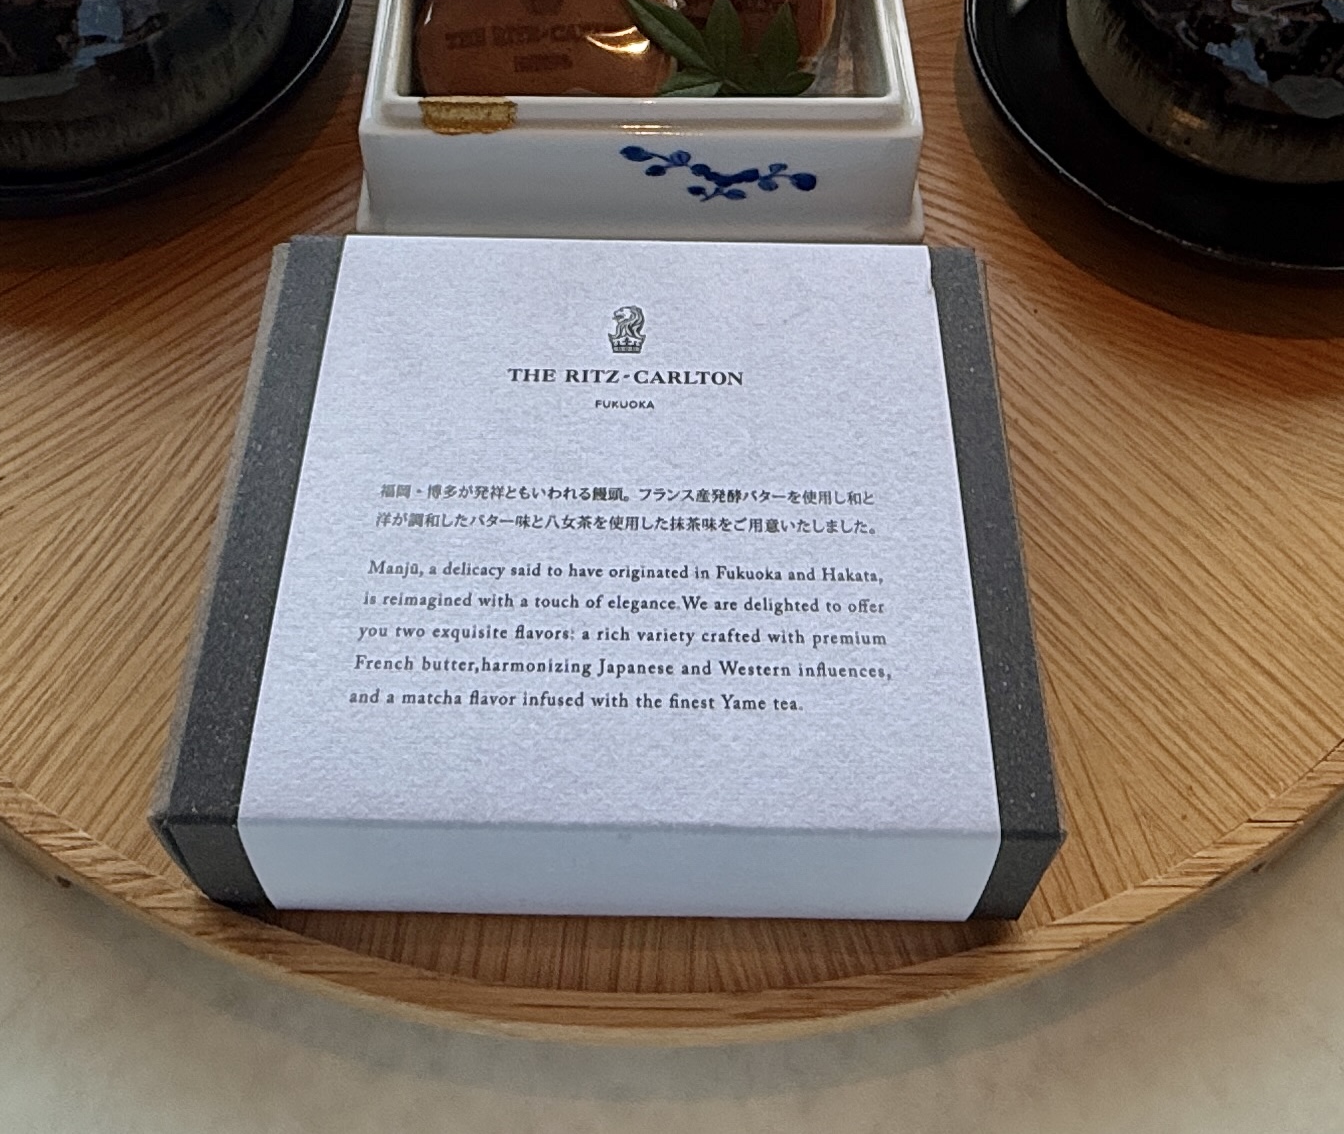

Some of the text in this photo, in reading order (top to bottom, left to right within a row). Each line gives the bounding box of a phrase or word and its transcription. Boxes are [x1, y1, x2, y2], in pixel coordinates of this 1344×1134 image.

[508, 368, 743, 385] THE RITZ-CARLTON
[595, 400, 654, 409] FUKUOKA
[429, 565, 437, 575] a
[443, 562, 505, 579] delicacy
[511, 564, 541, 576] said
[547, 566, 562, 577] to
[568, 563, 603, 577] have
[609, 565, 689, 582] originated
[695, 566, 709, 579] in
[716, 566, 782, 580] Fukuoka
[788, 567, 815, 581] and
[822, 567, 884, 584] Hakata,
[363, 592, 376, 605] is
[383, 593, 472, 609] reimagined
[479, 593, 513, 607] with
[520, 598, 528, 607] a
[535, 595, 579, 608] touch
[586, 594, 604, 608] of
[714, 601, 737, 611] are
[744, 597, 820, 615] delighted
[826, 602, 841, 613] to
[848, 599, 884, 613] offer
[358, 625, 886, 648] you two exquisite flavors: a rich variety crafted with premium
[354, 655, 413, 670] French
[597, 658, 674, 679] Japanese
[682, 661, 712, 675] and
[719, 660, 791, 677] Western
[798, 662, 892, 680] influences,
[349, 689, 803, 711] and a matcha flavor infused with the finest Yame tea.
